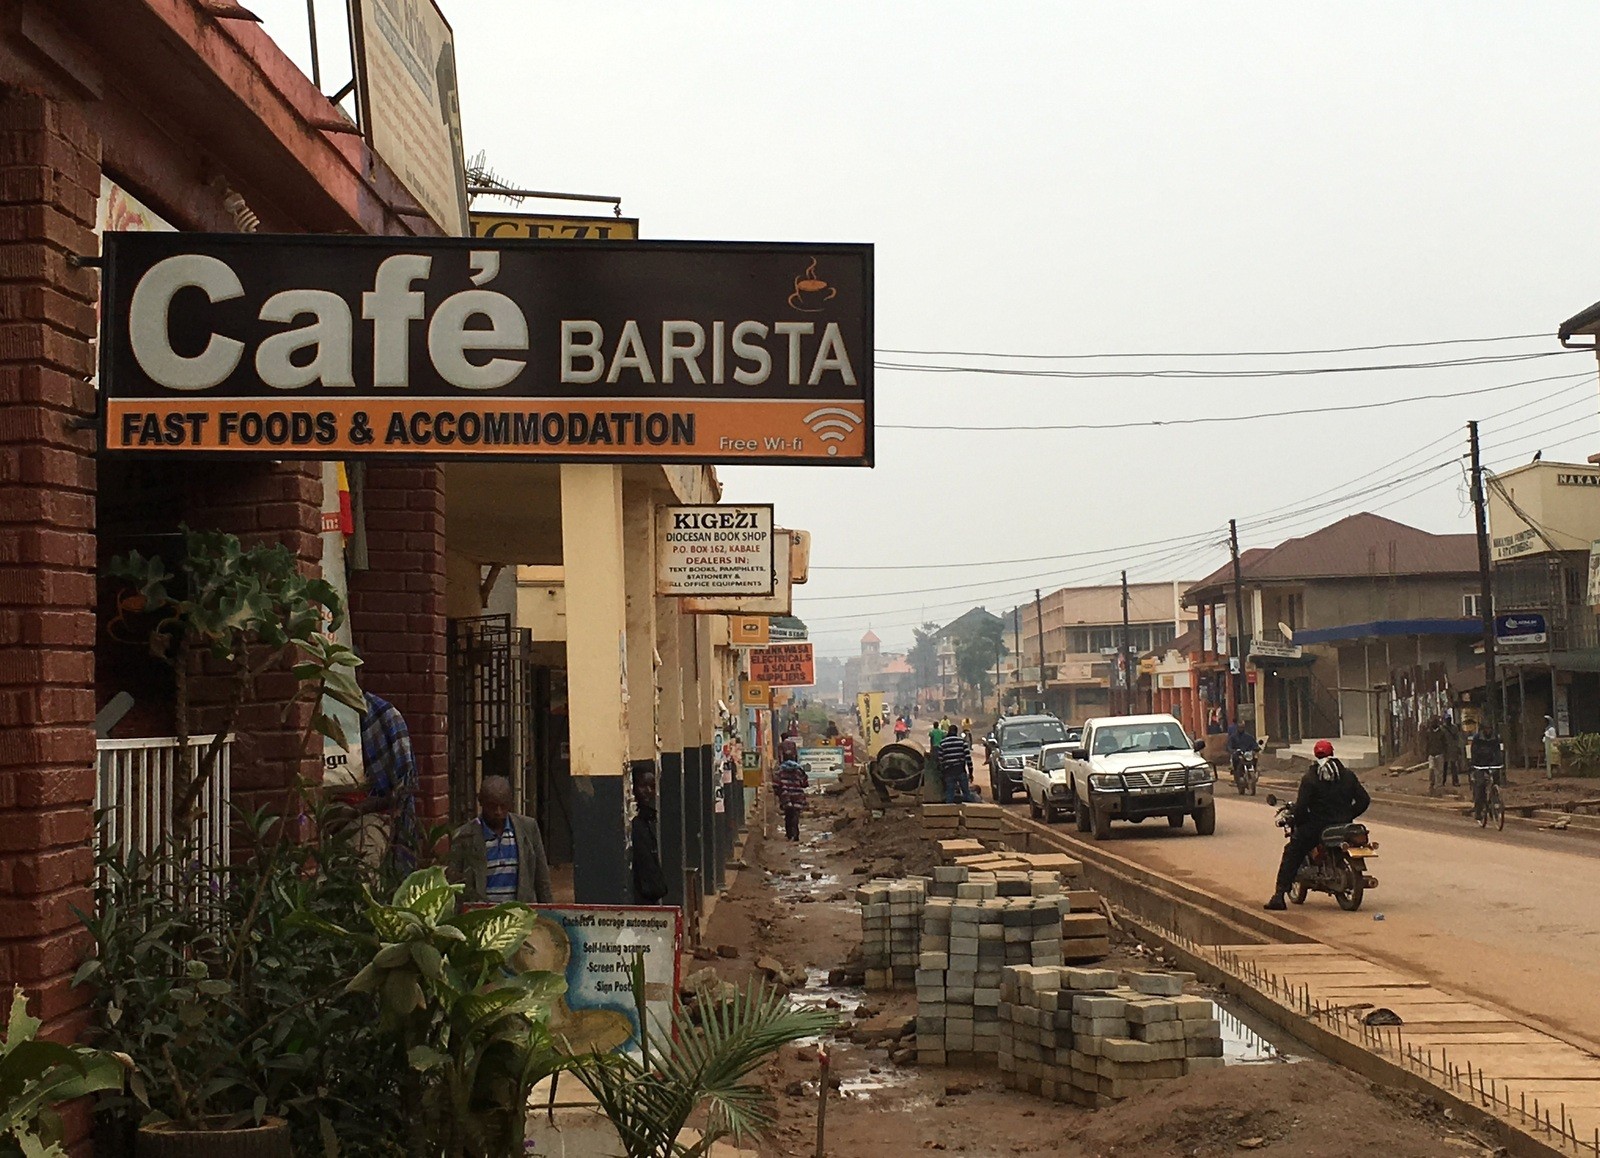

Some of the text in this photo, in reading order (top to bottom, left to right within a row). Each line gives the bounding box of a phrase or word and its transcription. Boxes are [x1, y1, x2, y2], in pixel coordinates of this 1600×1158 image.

[129, 250, 857, 390] Café BARISTA
[121, 411, 695, 446] FAST FOODS & ACCOMMODATION
[719, 436, 802, 451] Free Wi-fi
[673, 513, 758, 529] KIGEZI
[666, 531, 767, 542] DIOCESAN BOOK SHOP
[672, 545, 760, 554] P.O. BOX 162, KABALE
[750, 654, 812, 664] ELECTRICALS
[771, 663, 802, 672] SOLAR
[757, 672, 806, 681] SUPPLIERS
